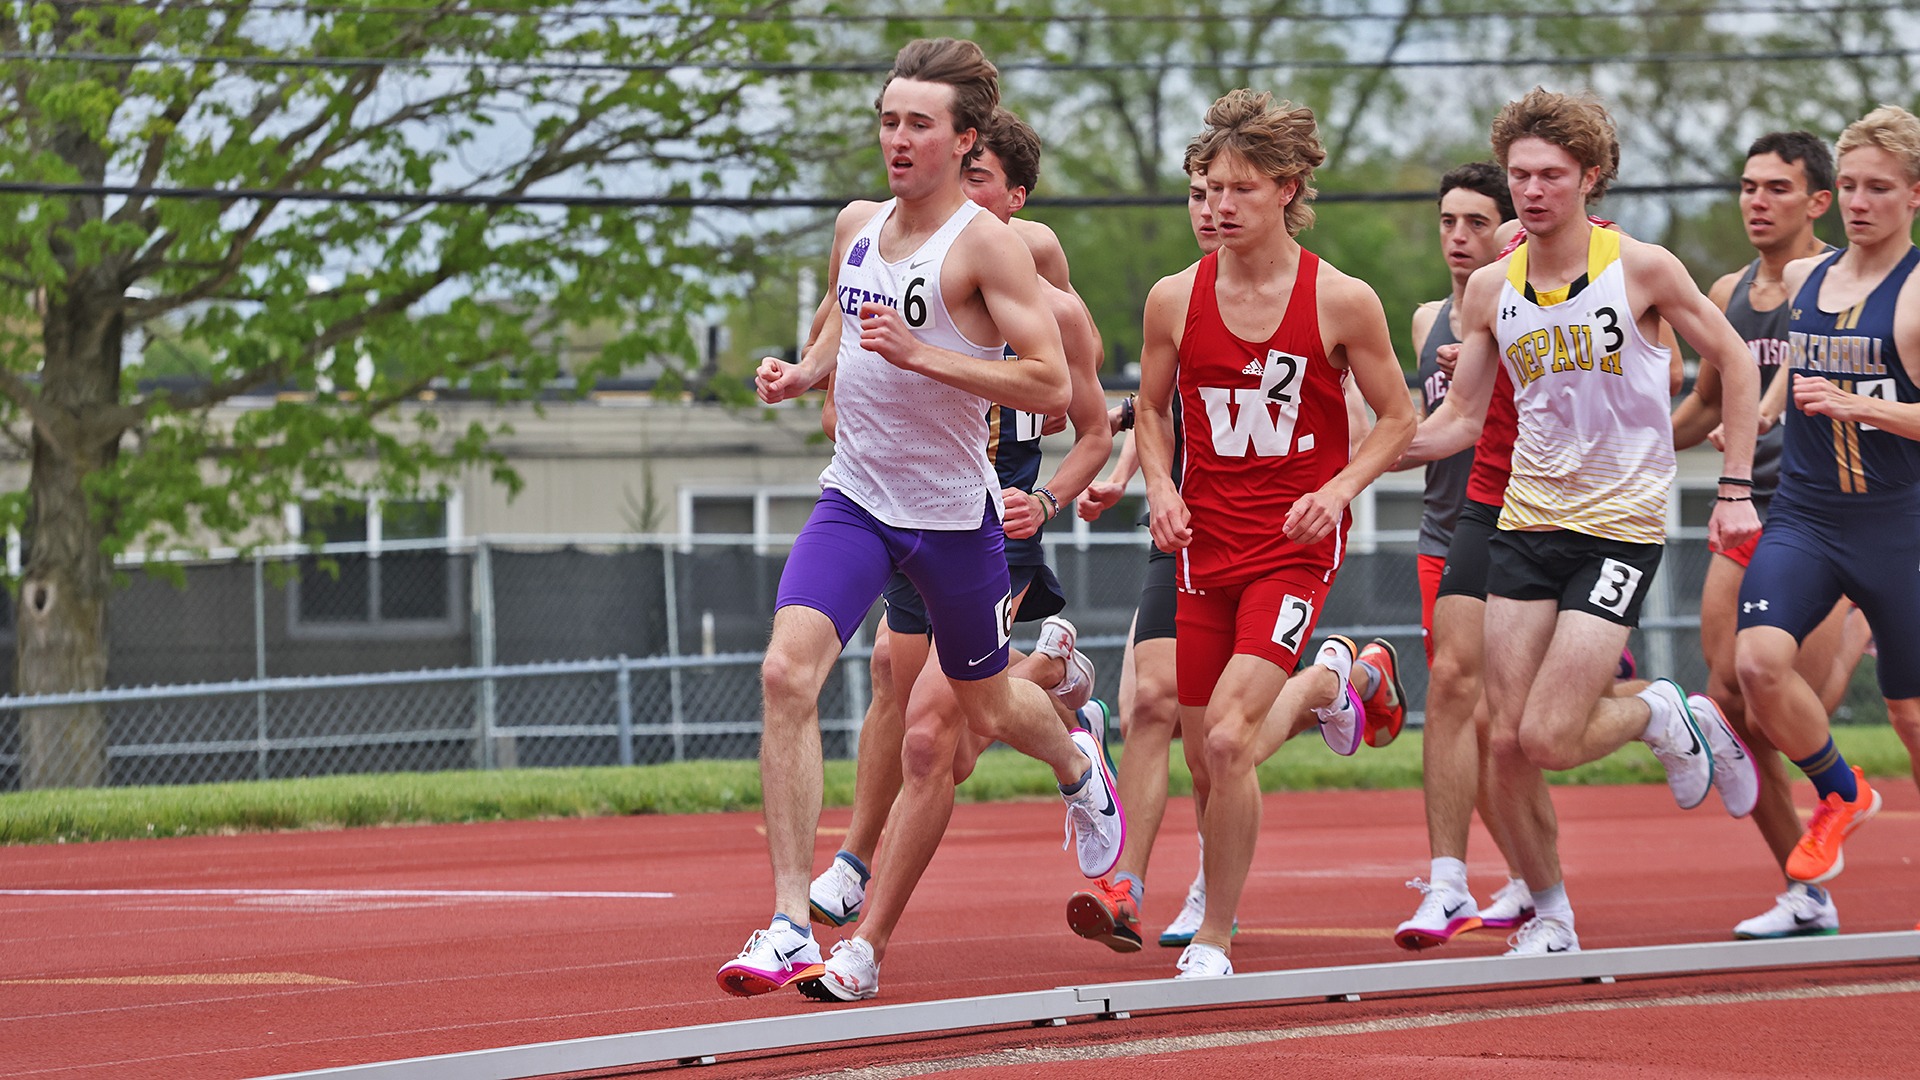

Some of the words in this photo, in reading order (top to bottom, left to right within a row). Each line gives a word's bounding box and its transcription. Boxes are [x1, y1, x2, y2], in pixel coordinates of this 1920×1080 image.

[904, 277, 927, 327] 6
[1595, 307, 1625, 352] 3
[1267, 356, 1297, 402] 2
[1599, 565, 1630, 607] 3
[1281, 602, 1307, 650] 2
